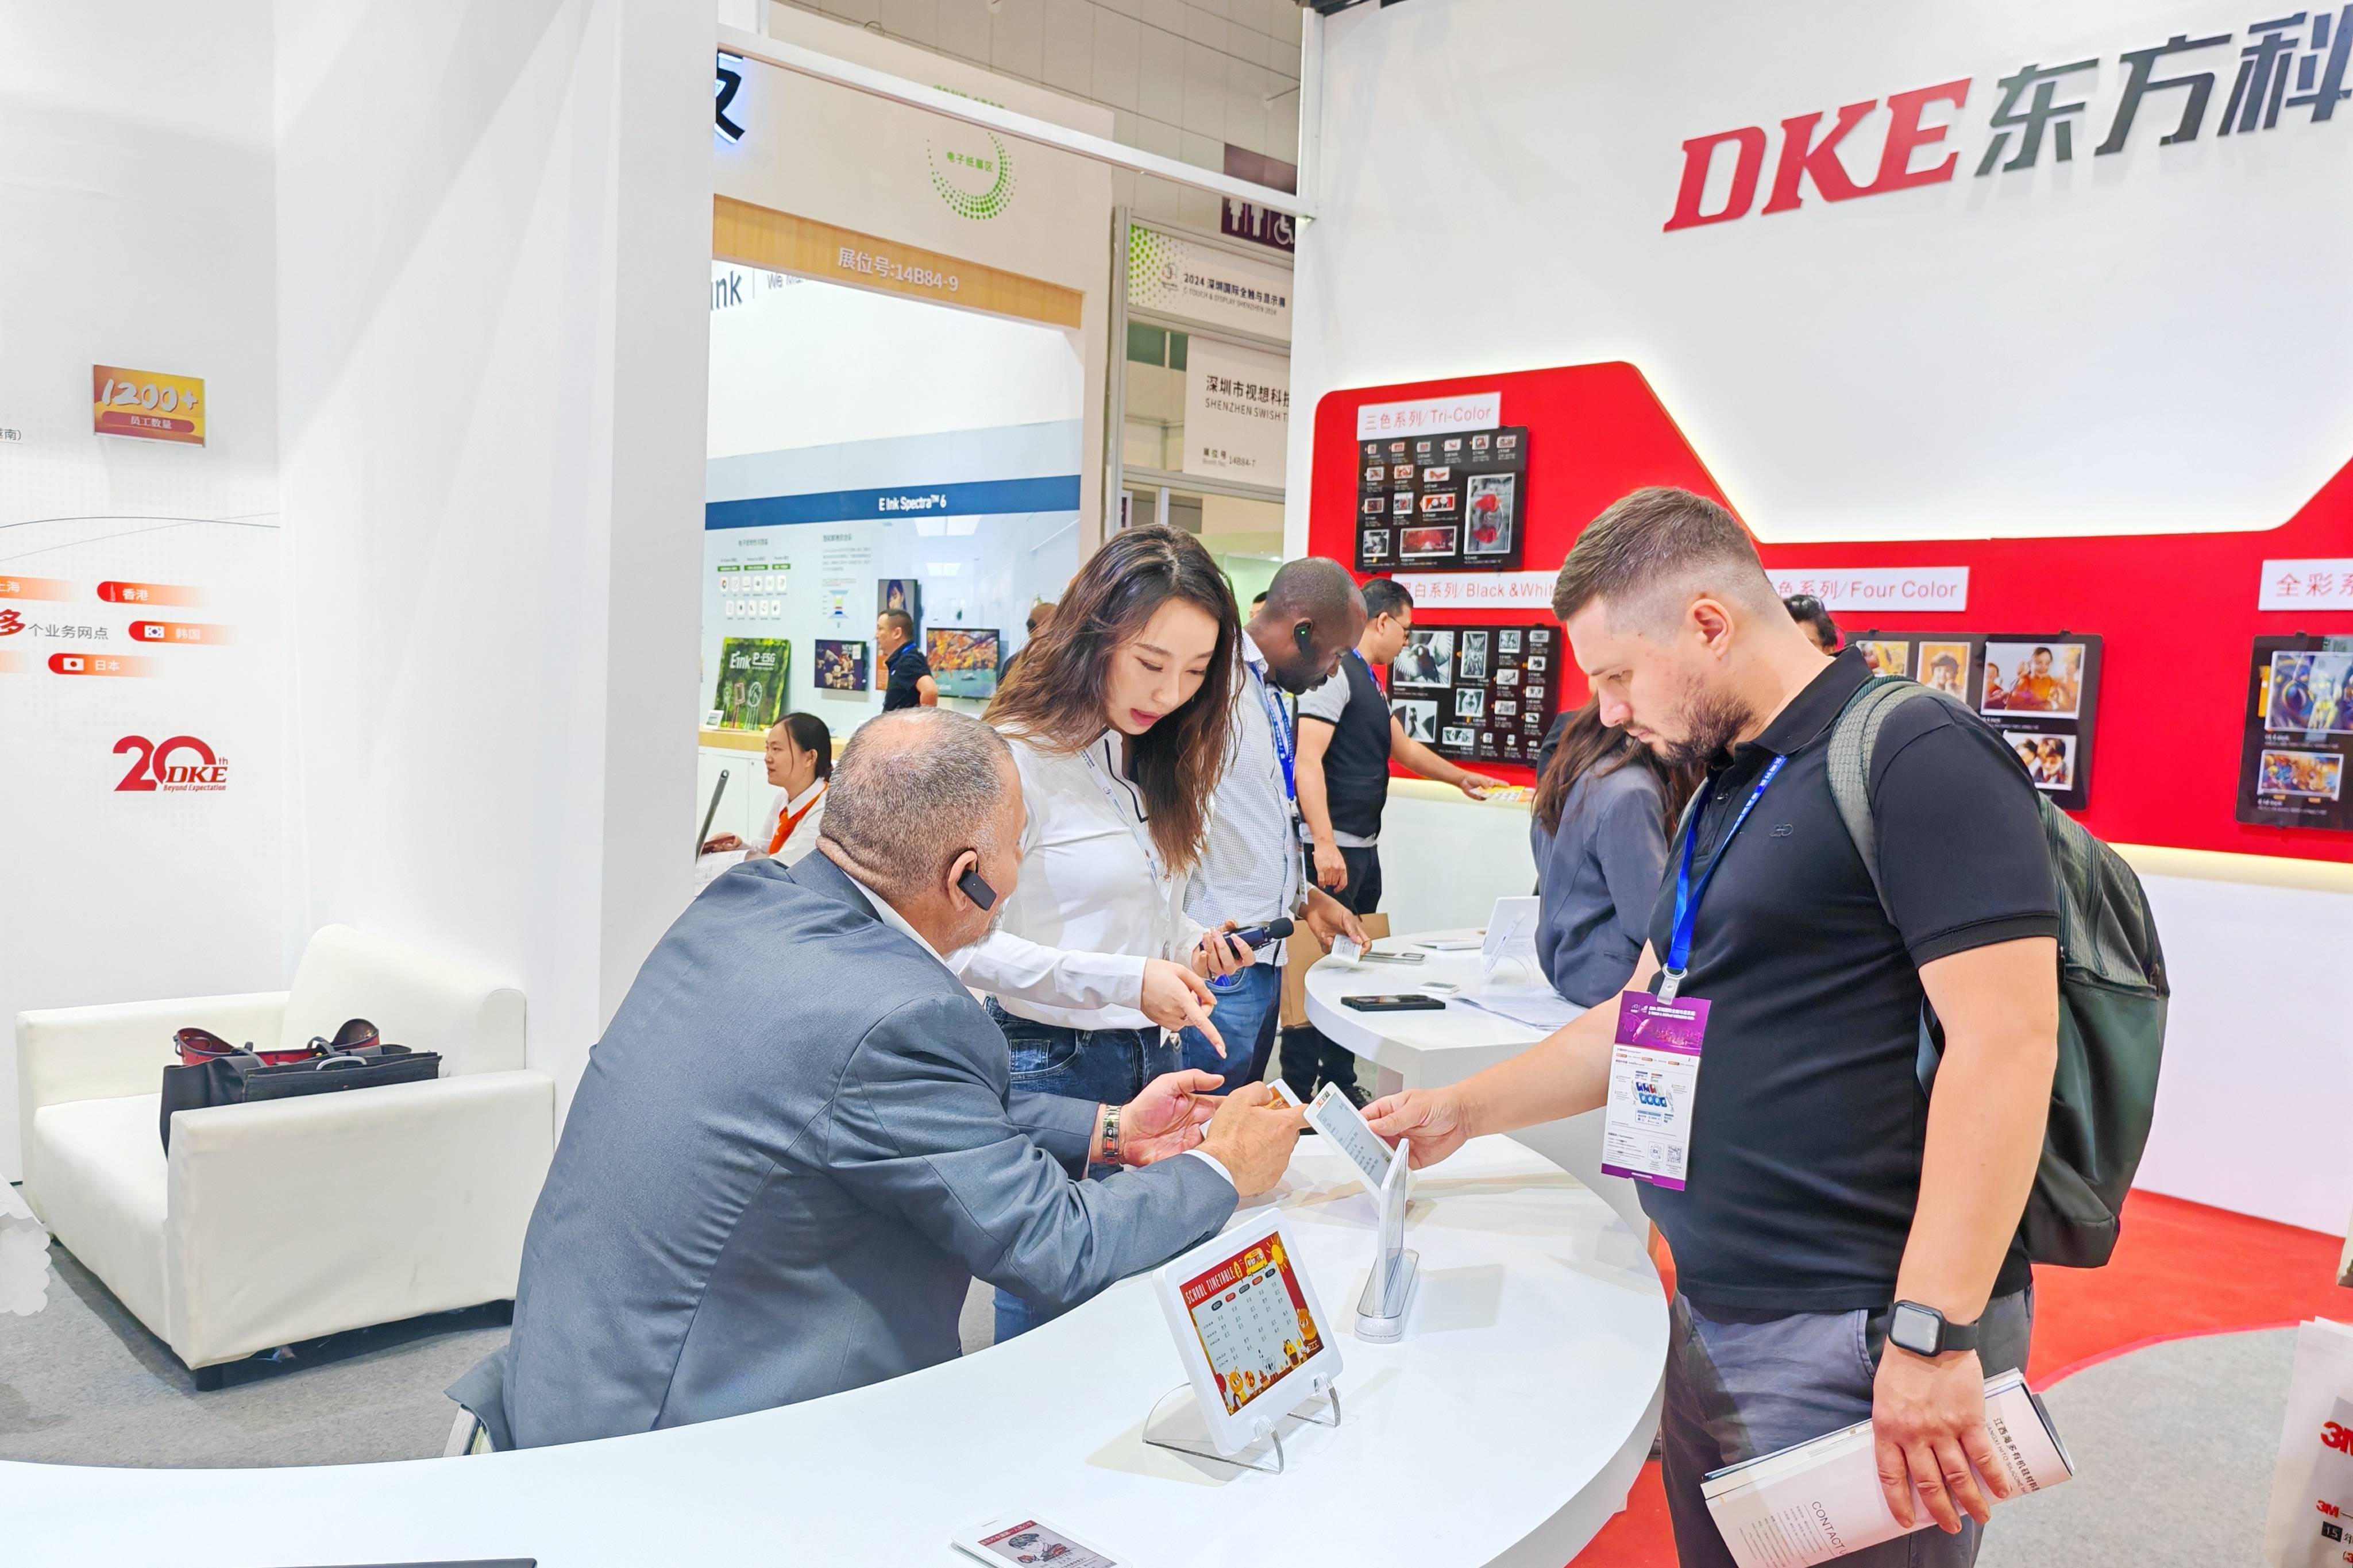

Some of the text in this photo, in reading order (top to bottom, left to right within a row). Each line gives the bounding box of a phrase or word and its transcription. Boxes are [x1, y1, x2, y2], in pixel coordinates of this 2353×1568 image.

[1974, 3, 2353, 177] 东方科
[1662, 77, 1973, 233] DKE
[838, 247, 959, 292] 展位号:14B84-9
[1184, 273, 1205, 287] 2024
[101, 378, 199, 412] 1200+
[1205, 397, 1252, 416] SHENZHEN
[1253, 408, 1280, 422] SWISH
[1364, 405, 1491, 431] 三色系列/Tri-Color
[130, 415, 173, 430] 员工数量
[878, 497, 885, 511] E
[940, 494, 947, 508] 6
[122, 588, 150, 601] 香港
[1901, 580, 1957, 598] Color
[28, 623, 109, 640] 个业务网点
[175, 628, 201, 640] 韩国
[94, 659, 121, 672] 日本
[218, 757, 228, 765] th
[165, 766, 228, 783] DKE
[163, 784, 226, 793] Beyond Expectation
[1185, 1283, 1208, 1304] SCHOOL
[1206, 1266, 1236, 1292] TIMETABLE
[2316, 1499, 2340, 1518] 3M
[1812, 1501, 1846, 1549] CONTACT
